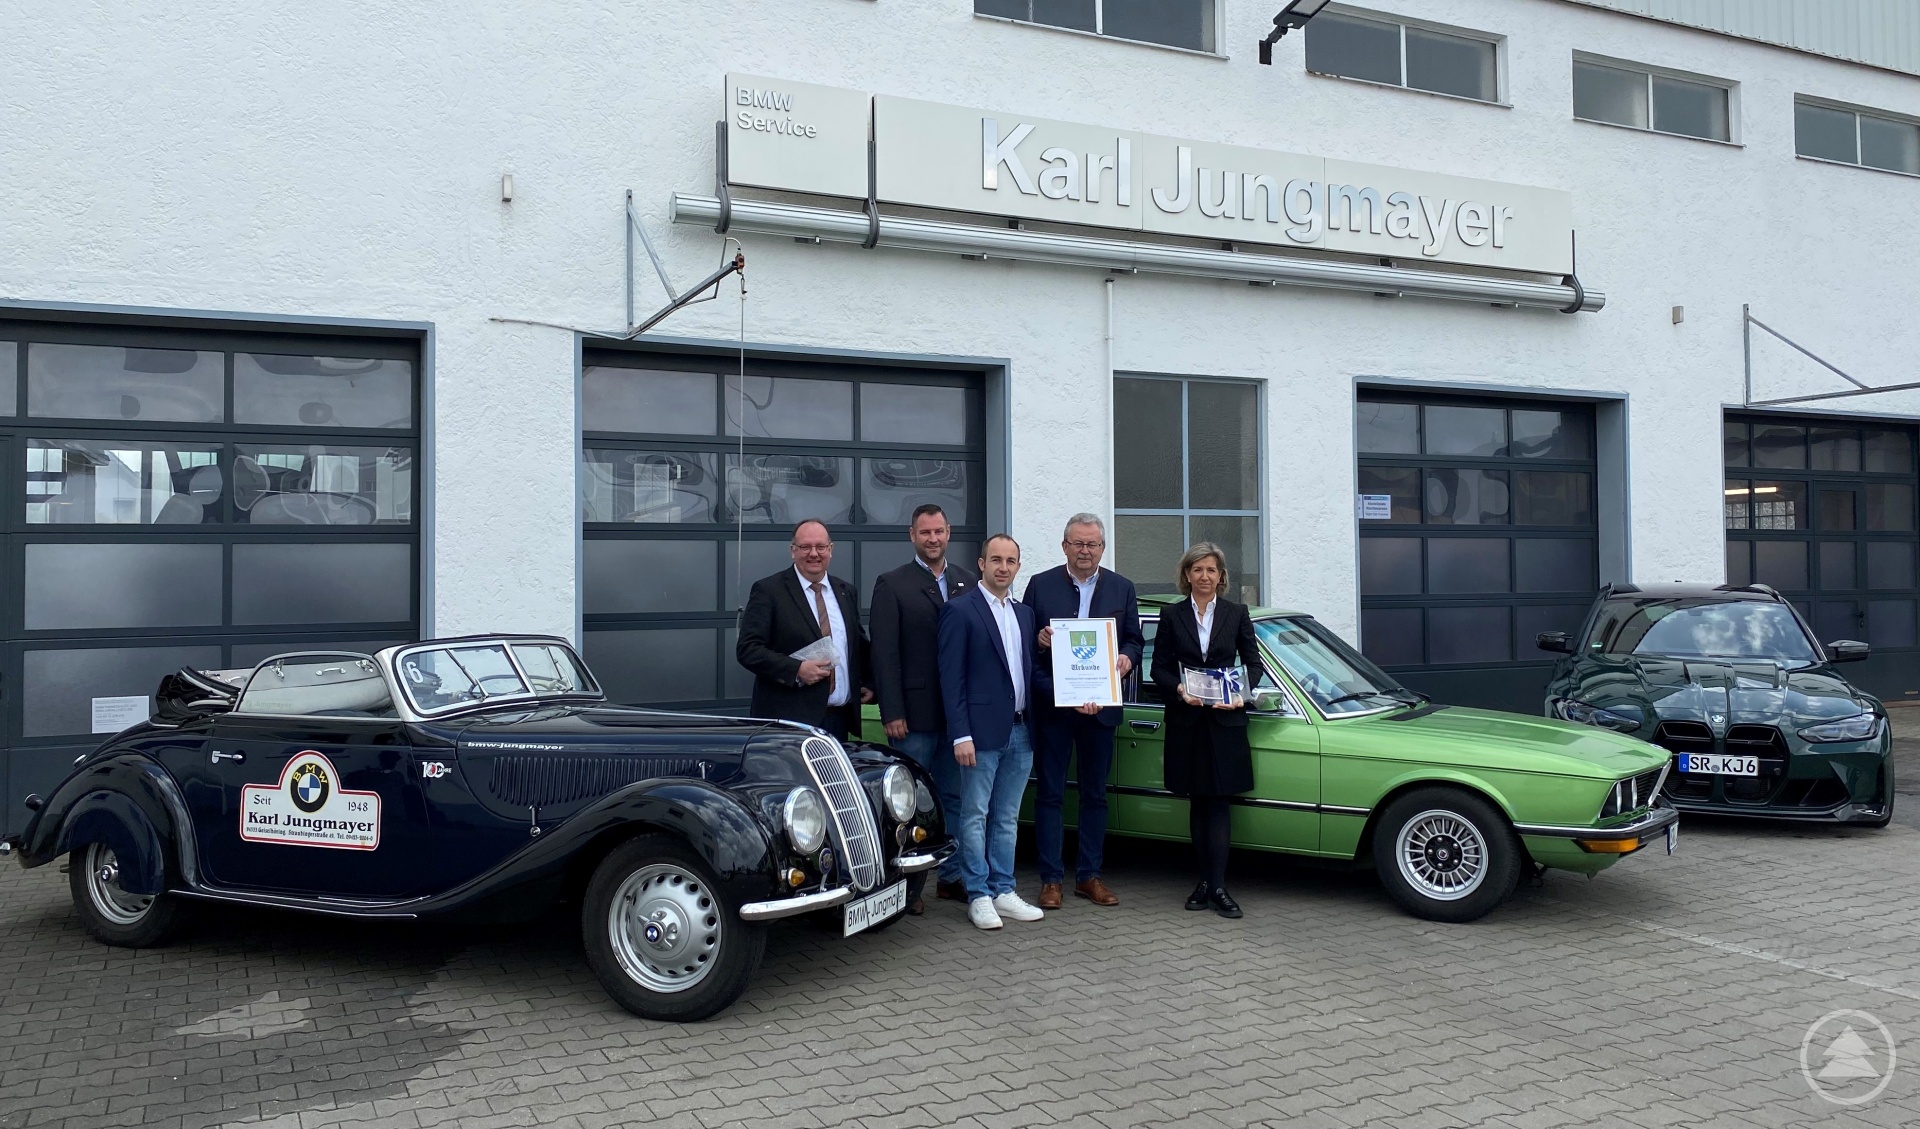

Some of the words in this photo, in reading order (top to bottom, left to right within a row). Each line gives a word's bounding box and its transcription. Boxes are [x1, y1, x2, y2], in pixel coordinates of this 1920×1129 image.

[736, 86, 793, 112] BMW
[737, 110, 816, 138] Service
[982, 117, 1131, 207] Karl
[1151, 145, 1514, 256] Jungmayer
[405, 661, 424, 684] 6
[467, 741, 565, 751] bmw-jungmayer
[292, 764, 328, 784] BMW
[1690, 756, 1710, 771] SR
[253, 794, 272, 806] Seit
[347, 801, 369, 812] 1948
[248, 811, 279, 826] Karl
[282, 814, 375, 834] Jungmayer
